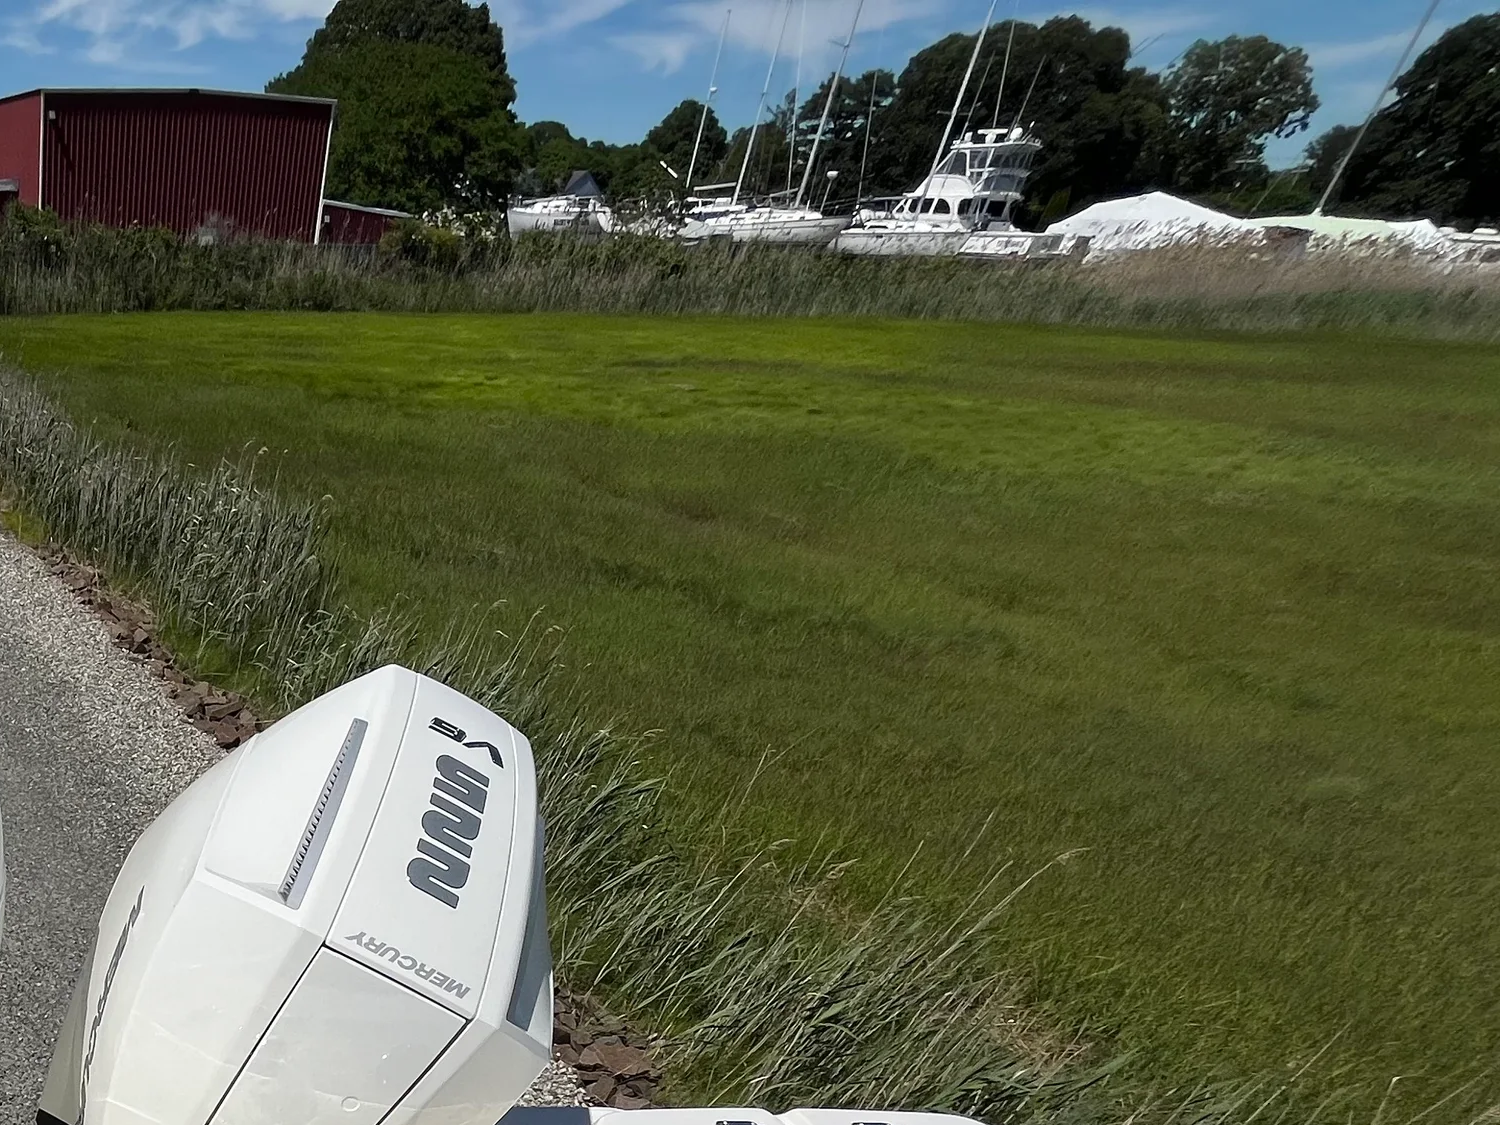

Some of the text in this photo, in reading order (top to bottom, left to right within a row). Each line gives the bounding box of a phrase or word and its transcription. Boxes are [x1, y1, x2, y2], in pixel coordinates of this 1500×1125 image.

[429, 716, 504, 769] V6
[406, 753, 490, 910] 225
[345, 930, 471, 999] MERCURY
